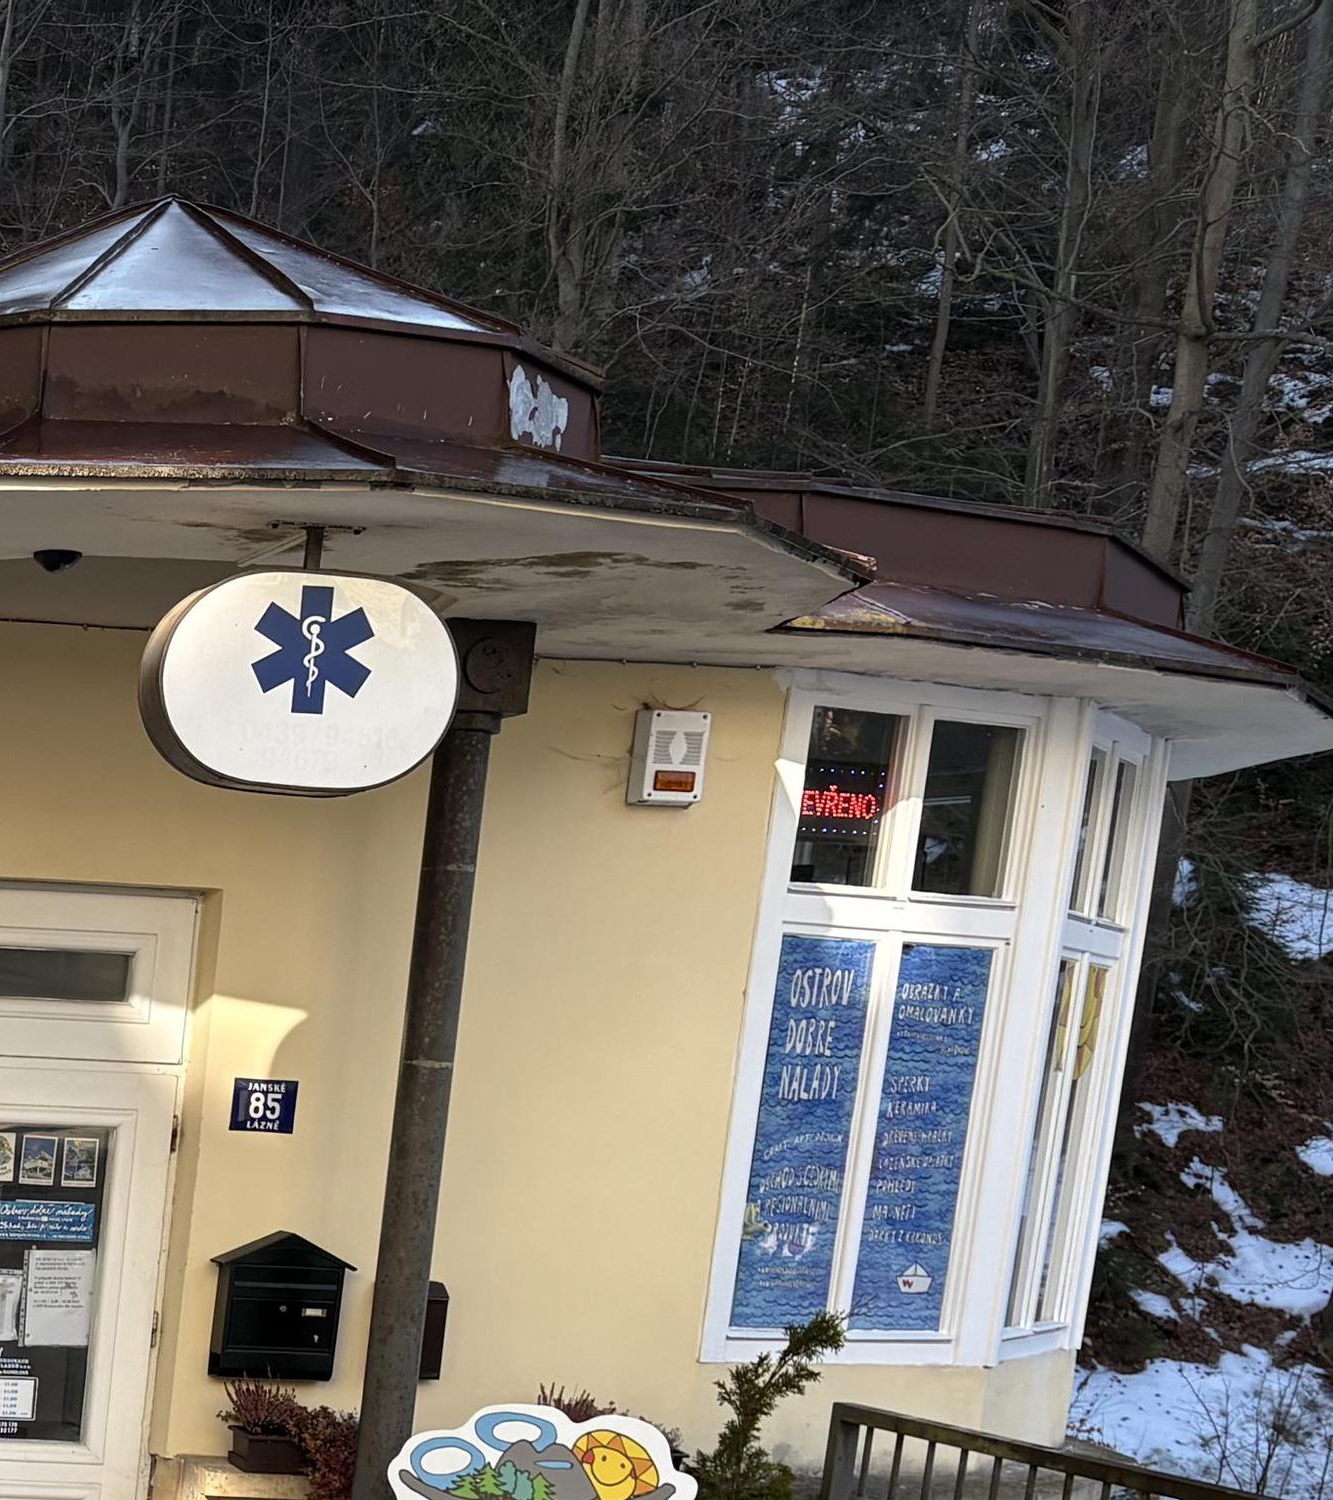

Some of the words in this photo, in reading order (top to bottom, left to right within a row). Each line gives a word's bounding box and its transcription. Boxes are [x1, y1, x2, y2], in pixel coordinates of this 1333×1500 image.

[790, 968, 855, 1008] OSTROV
[248, 1082, 286, 1092] JANSKÉ
[249, 1092, 282, 1120] 85
[246, 1119, 280, 1130] LÁZNĚ
